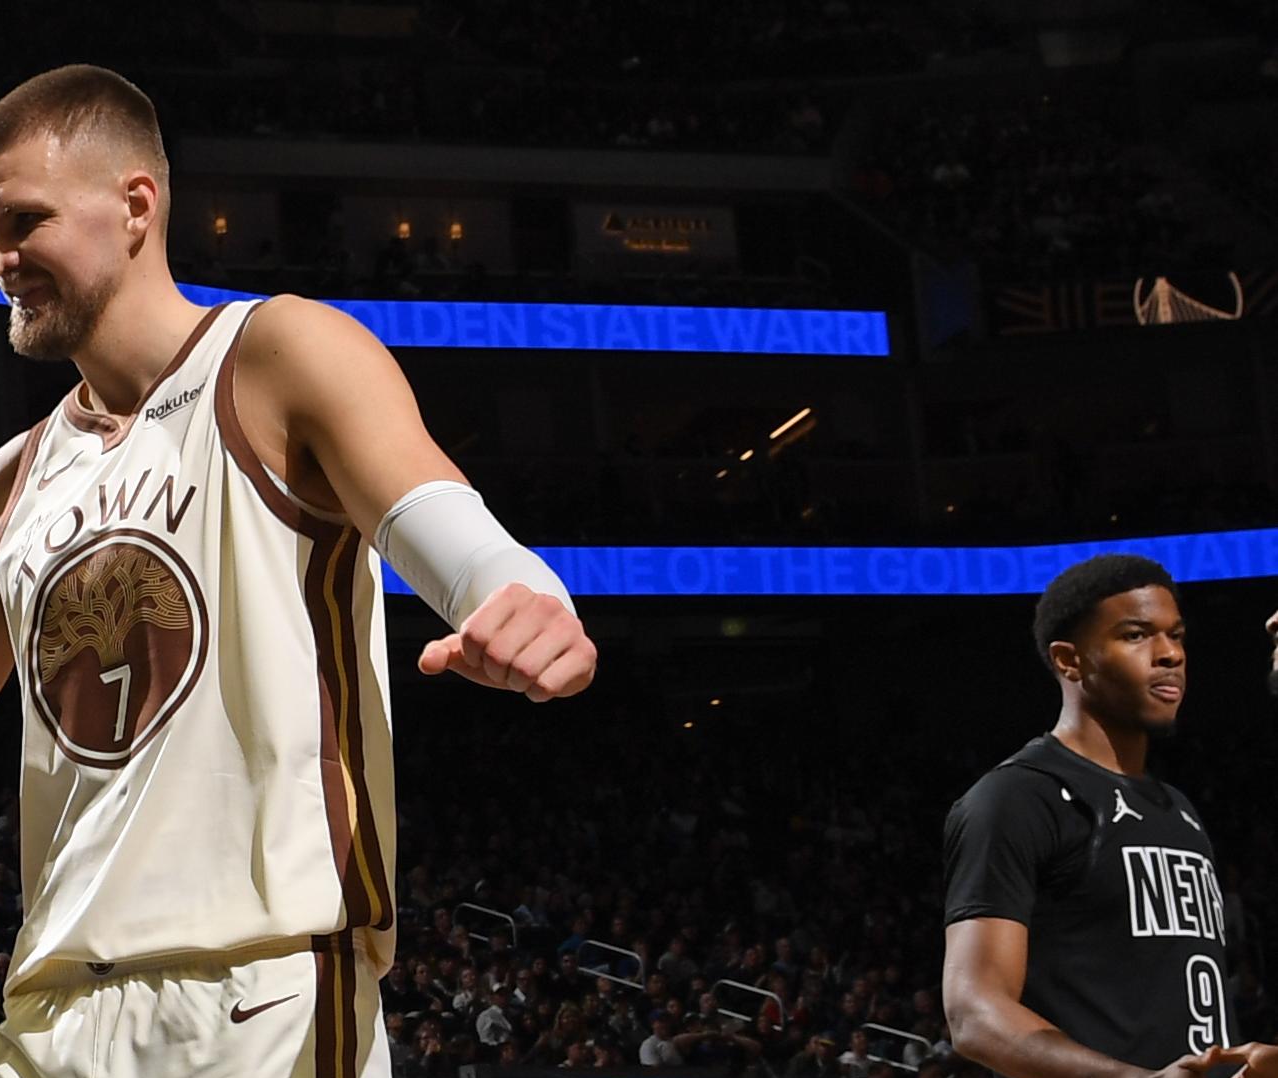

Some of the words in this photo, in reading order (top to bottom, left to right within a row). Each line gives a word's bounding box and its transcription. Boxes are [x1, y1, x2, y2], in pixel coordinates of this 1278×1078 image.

[347, 301, 526, 346] OLDEN
[537, 303, 695, 351] STATE
[708, 308, 885, 356] WARRI
[15, 467, 197, 586] TOWN
[667, 548, 739, 594] OF
[750, 547, 852, 594] THE
[99, 663, 131, 741] 7
[1121, 846, 1227, 947] NETS
[1186, 953, 1231, 1057] 9
